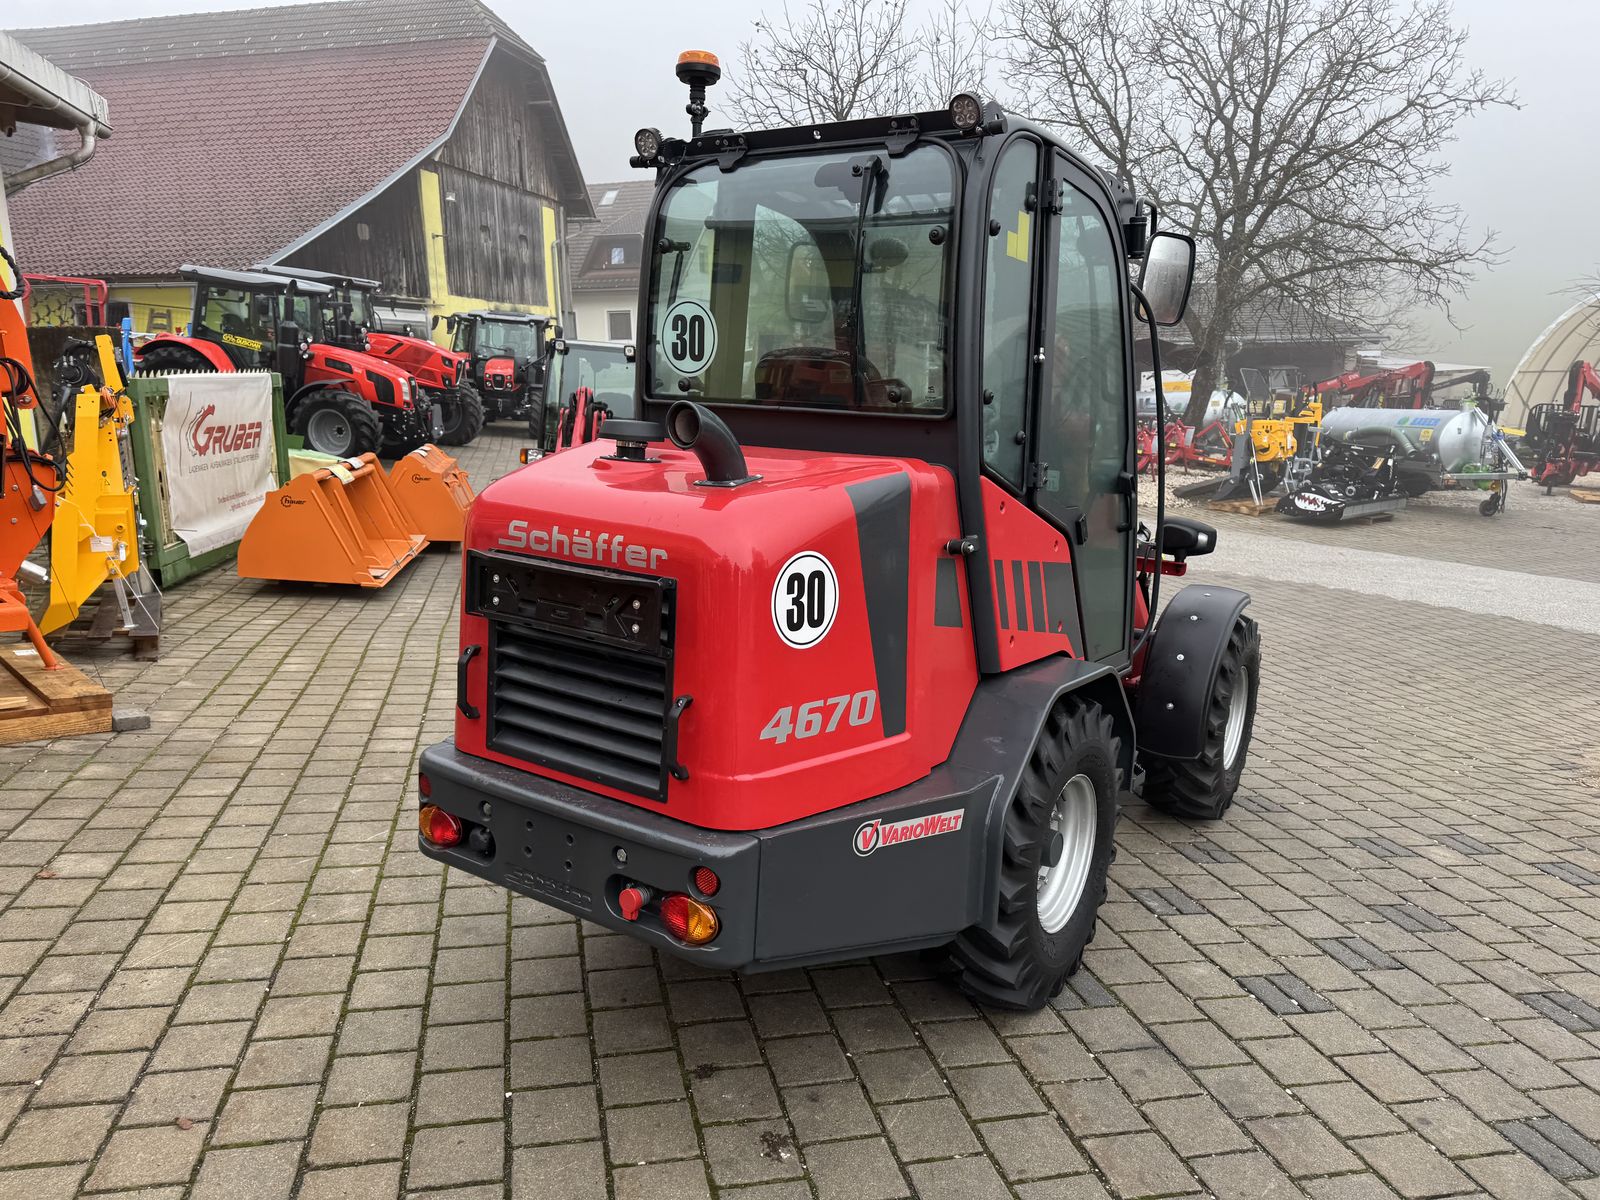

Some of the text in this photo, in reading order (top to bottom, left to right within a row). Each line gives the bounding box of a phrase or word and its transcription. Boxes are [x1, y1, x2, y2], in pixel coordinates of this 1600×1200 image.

[672, 314, 705, 362] 30
[192, 404, 262, 456] GRUBER
[498, 519, 668, 570] Schäffer
[786, 569, 826, 632] 30
[759, 689, 876, 744] 4670
